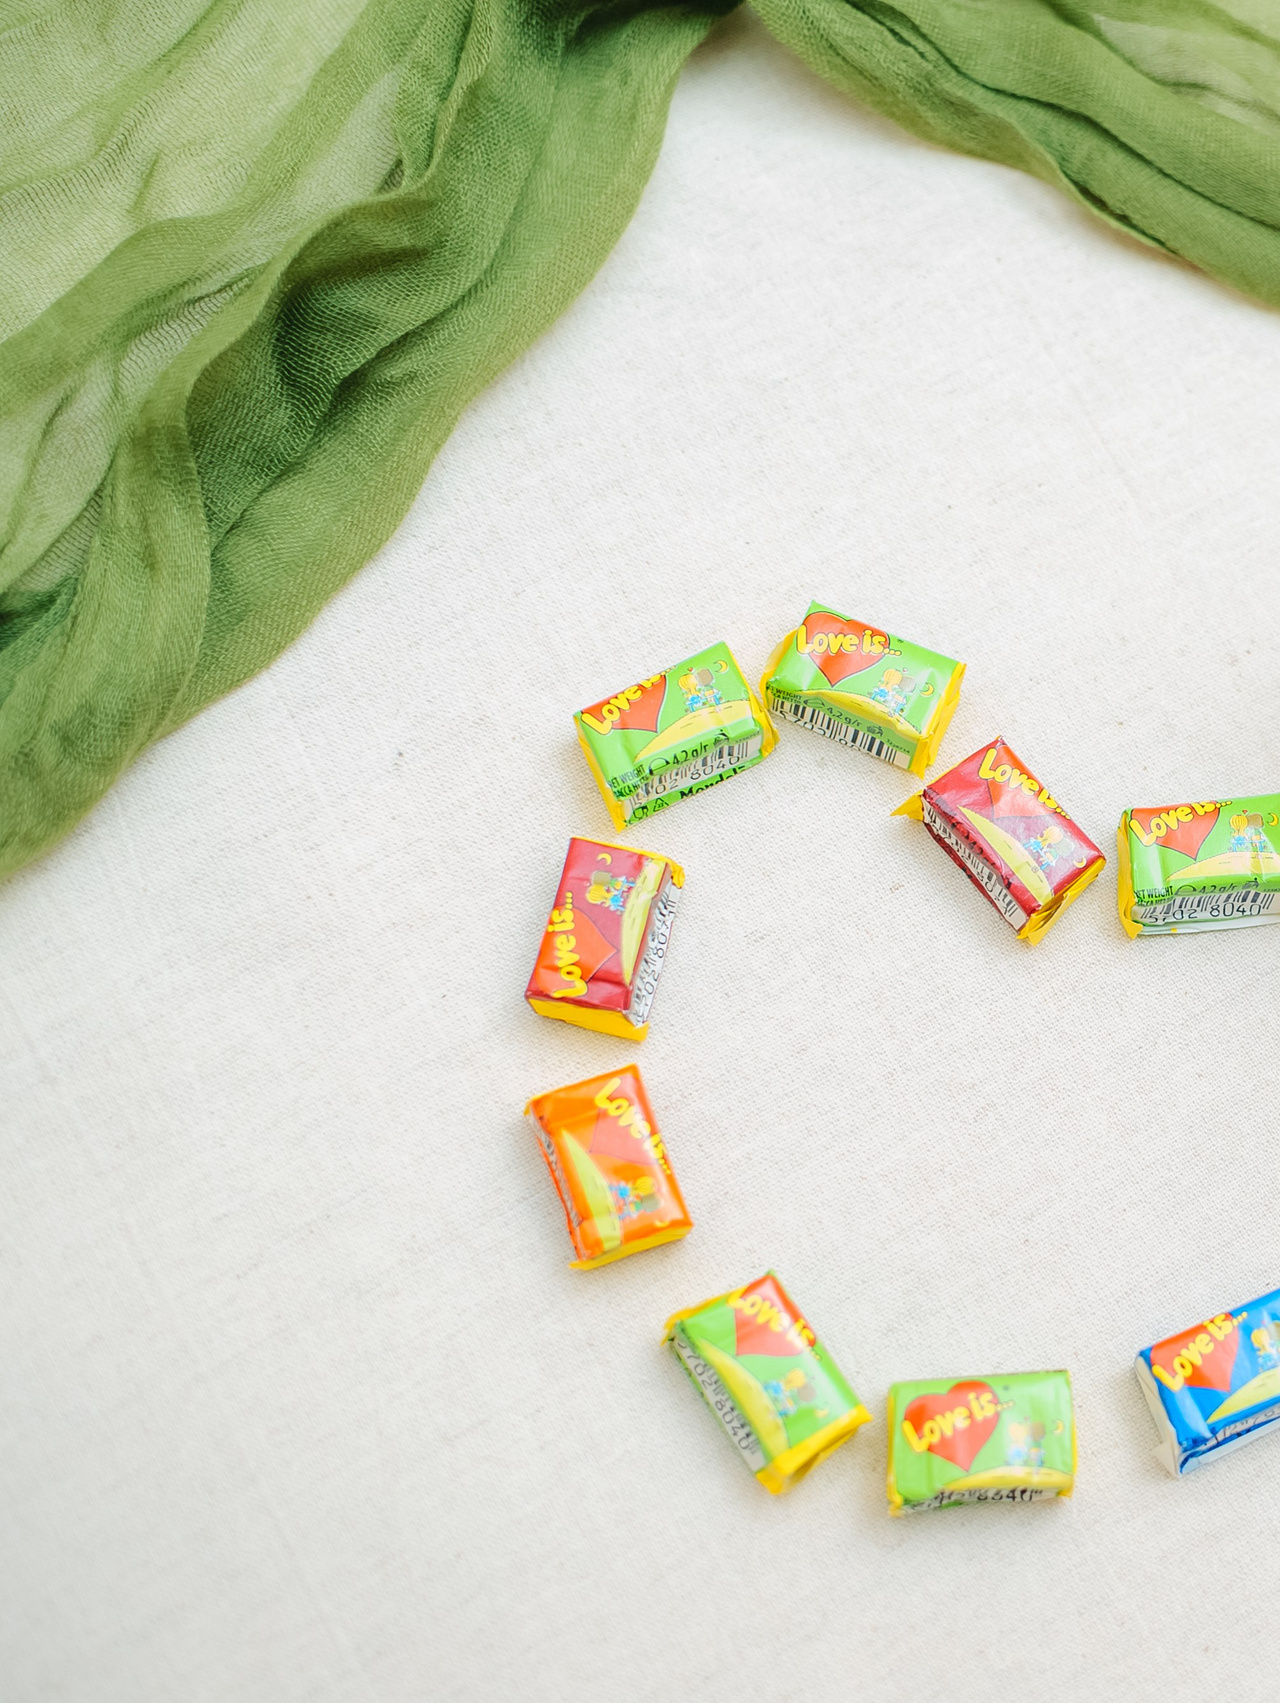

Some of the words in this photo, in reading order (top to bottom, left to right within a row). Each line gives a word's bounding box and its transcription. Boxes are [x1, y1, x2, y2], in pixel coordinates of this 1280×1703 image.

[796, 624, 859, 655] Love
[862, 629, 902, 656] is...
[581, 687, 642, 735] Love
[672, 750, 689, 765] 4,2
[690, 756, 740, 780] 8040
[979, 748, 1040, 796] Love
[1129, 807, 1194, 847] Love
[1191, 800, 1233, 816] is...
[547, 892, 575, 933] is...
[1209, 903, 1262, 918] 8040
[552, 934, 589, 999] Love
[594, 1077, 651, 1139] Love
[727, 1286, 791, 1333] Love
[1152, 1333, 1215, 1392] Love
[1203, 1312, 1248, 1341] is...
[714, 1399, 752, 1451] 8040
[902, 1406, 971, 1453] Love
[968, 1391, 1015, 1420] is...
